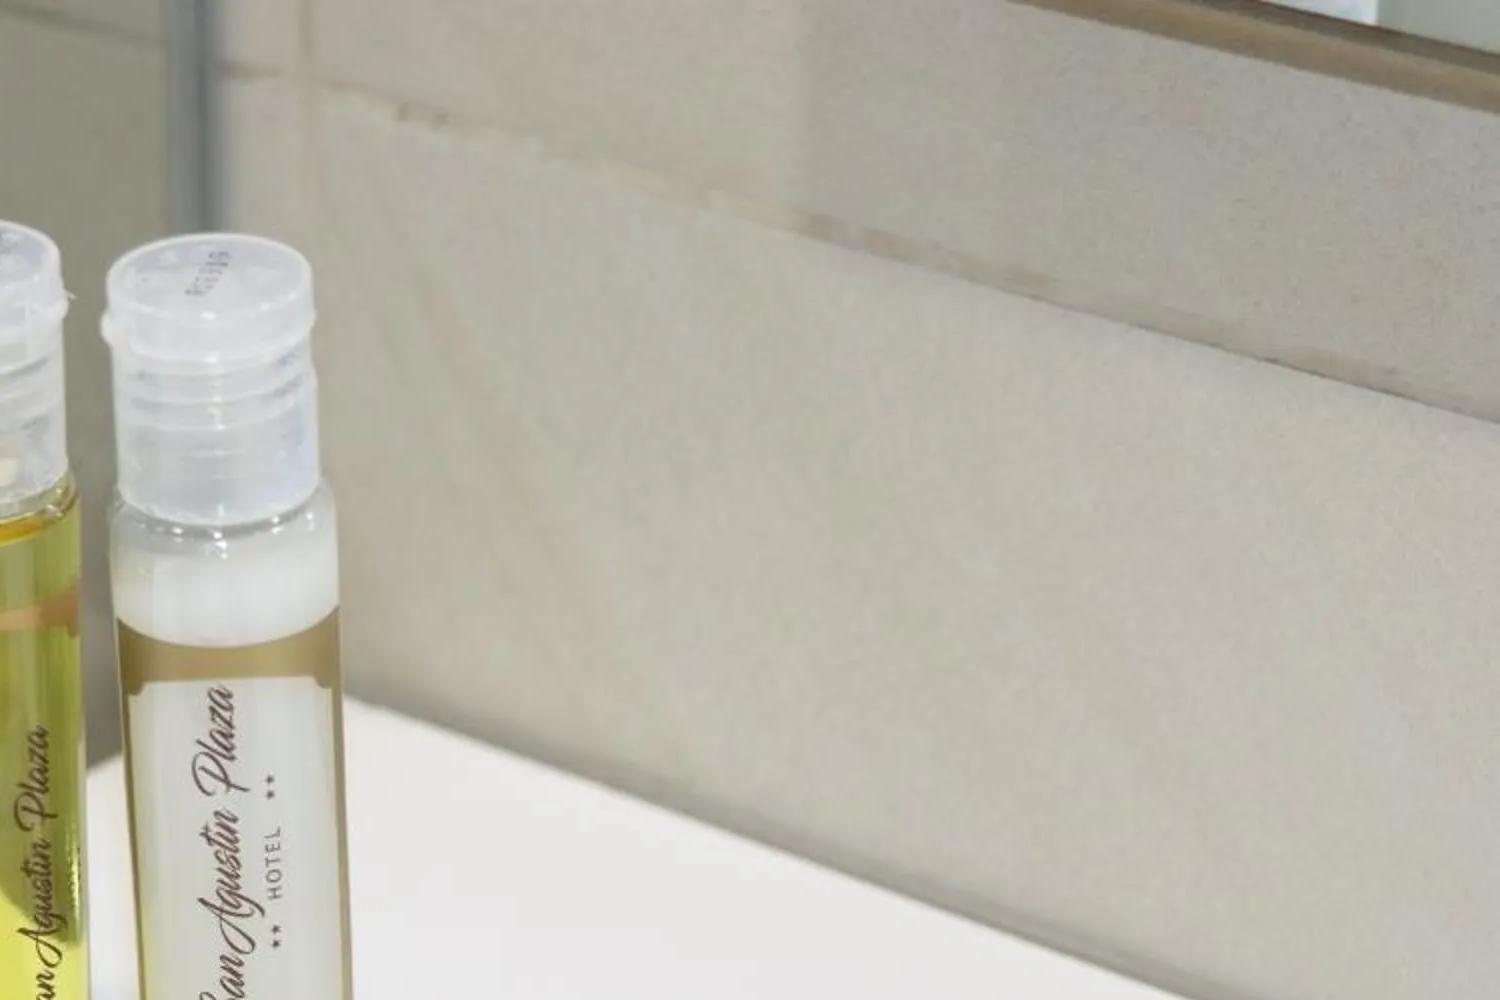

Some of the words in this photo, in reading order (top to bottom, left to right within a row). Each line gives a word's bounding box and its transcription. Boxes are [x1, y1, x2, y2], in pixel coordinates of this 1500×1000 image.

[13, 724, 58, 832] Plaza
[192, 684, 251, 797] Plaza
[264, 826, 284, 901] HOTEL
